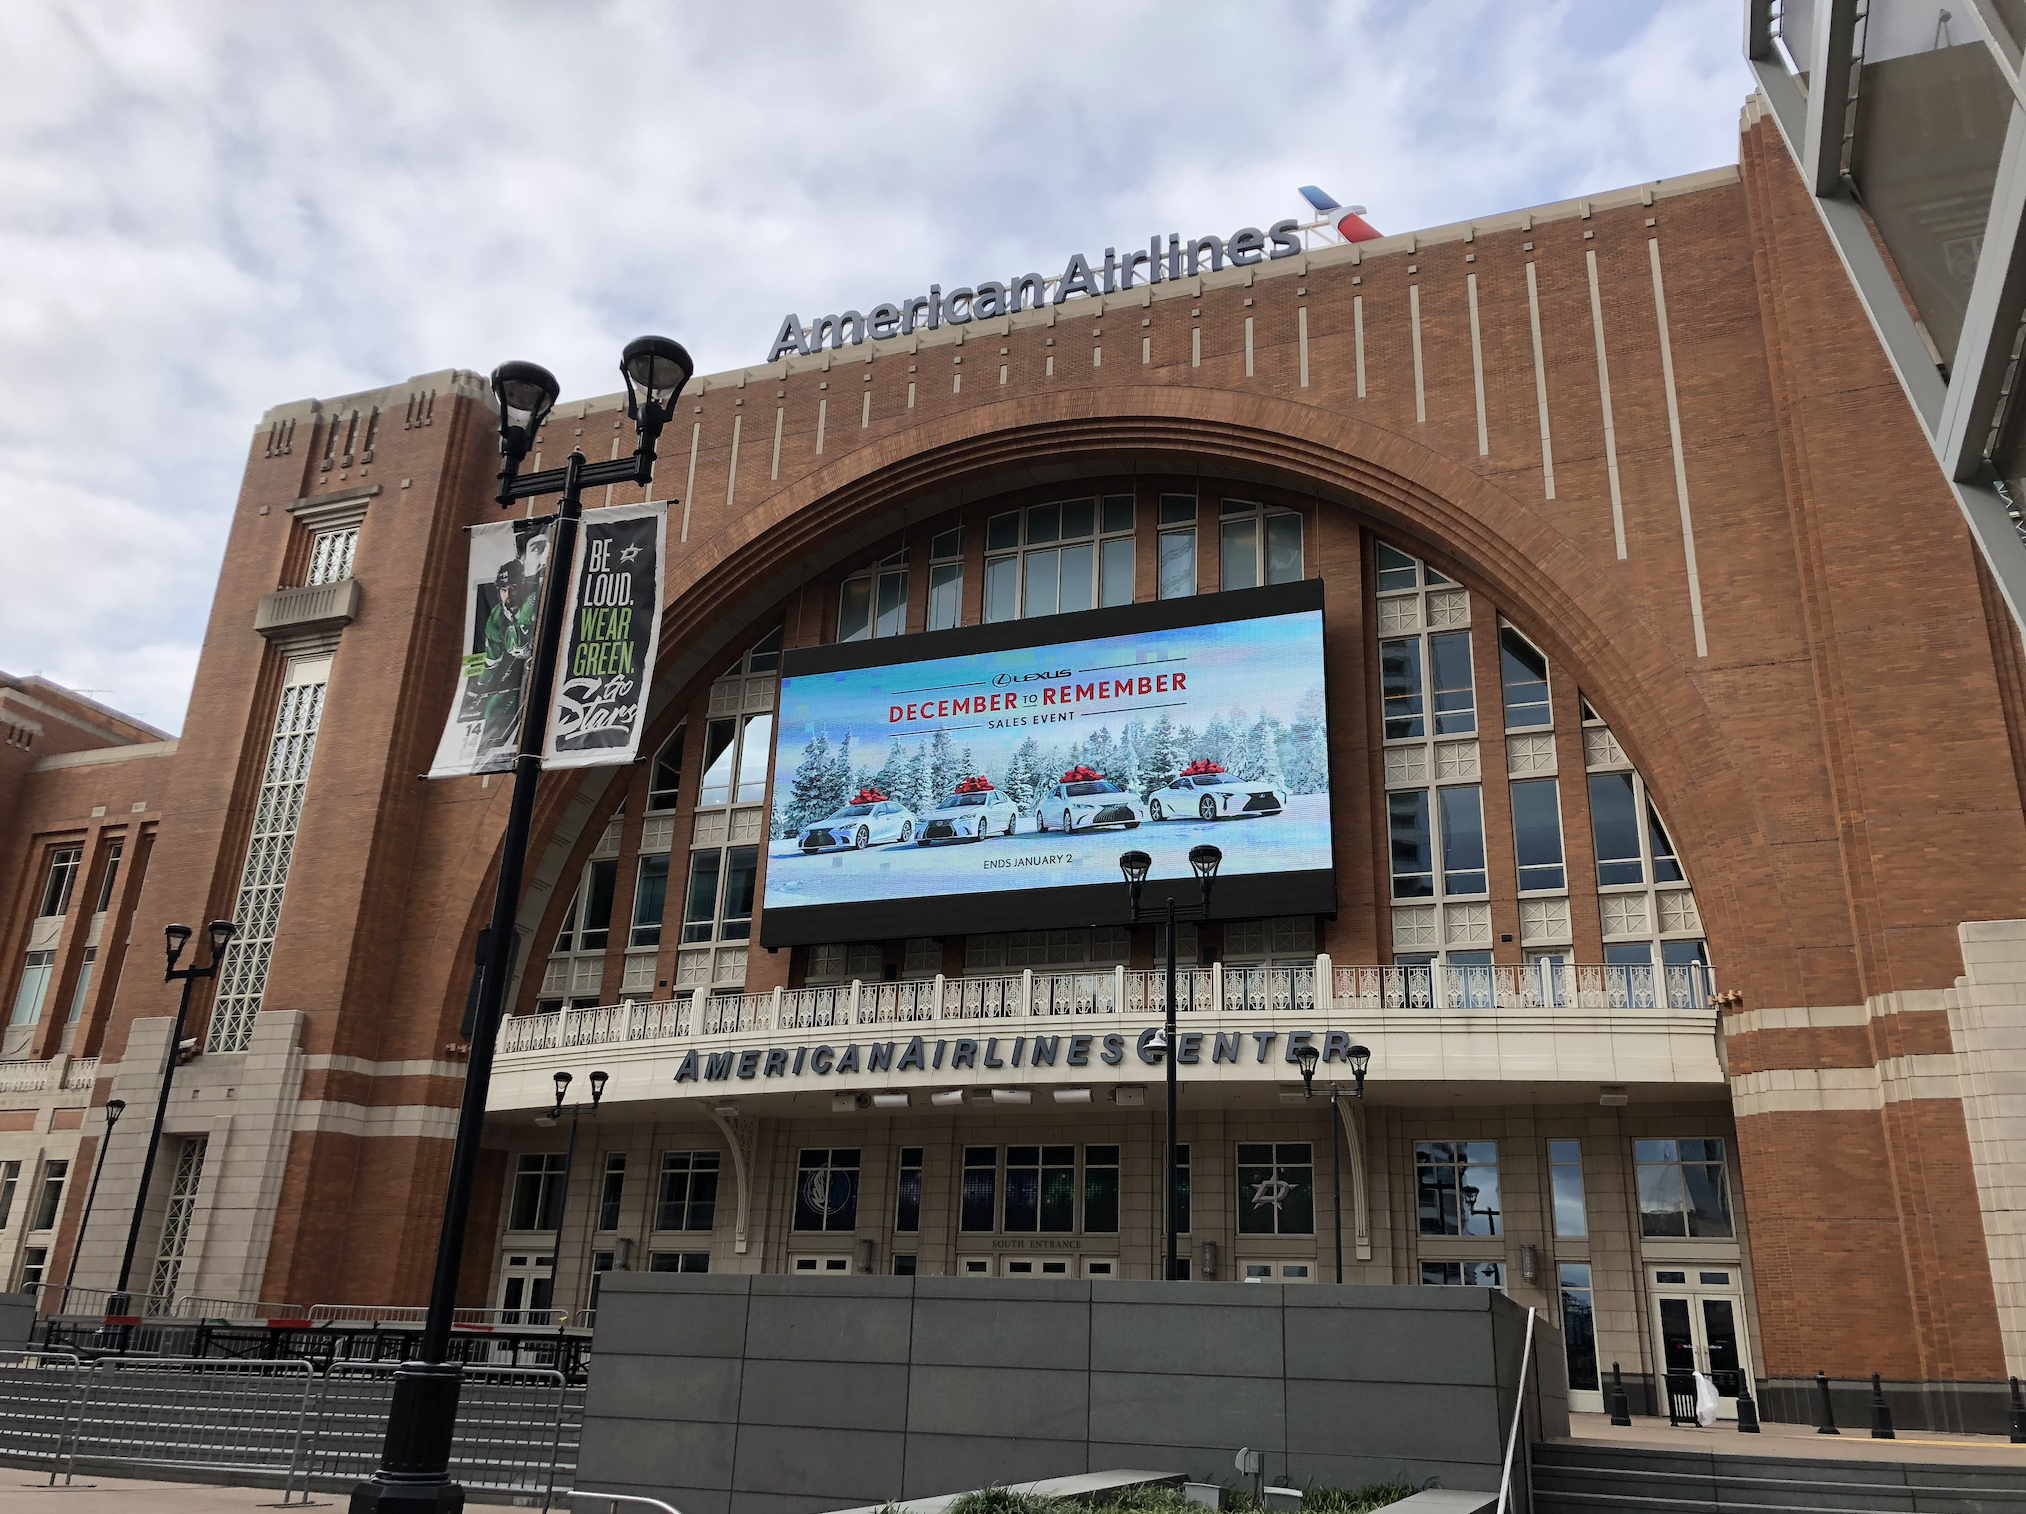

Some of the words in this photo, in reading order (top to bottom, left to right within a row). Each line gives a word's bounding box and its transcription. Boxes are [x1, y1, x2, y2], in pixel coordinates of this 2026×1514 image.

[768, 272, 1045, 363] American
[1053, 218, 1302, 305] Airlines
[589, 538, 613, 573] BE
[583, 571, 634, 607] LOUD.
[580, 607, 632, 641] WEAR
[573, 640, 635, 676] GREEN.
[603, 673, 634, 700] Go
[1013, 669, 1072, 683] LEXUS
[557, 677, 638, 737] Stars
[889, 692, 1018, 723] DECEMBER
[1022, 694, 1038, 705] TO
[1042, 672, 1187, 706] REMEMBER
[466, 722, 482, 737] 14
[988, 716, 1027, 730] SALES
[1033, 711, 1075, 725] EVENT
[983, 858, 1012, 870] ENDS
[1013, 854, 1064, 868] JANUARY
[1066, 853, 1073, 863] 2
[1136, 1027, 1352, 1065] CENTER
[992, 1240, 1024, 1249] SOUTH
[1030, 1240, 1082, 1249] ENTRANCE
